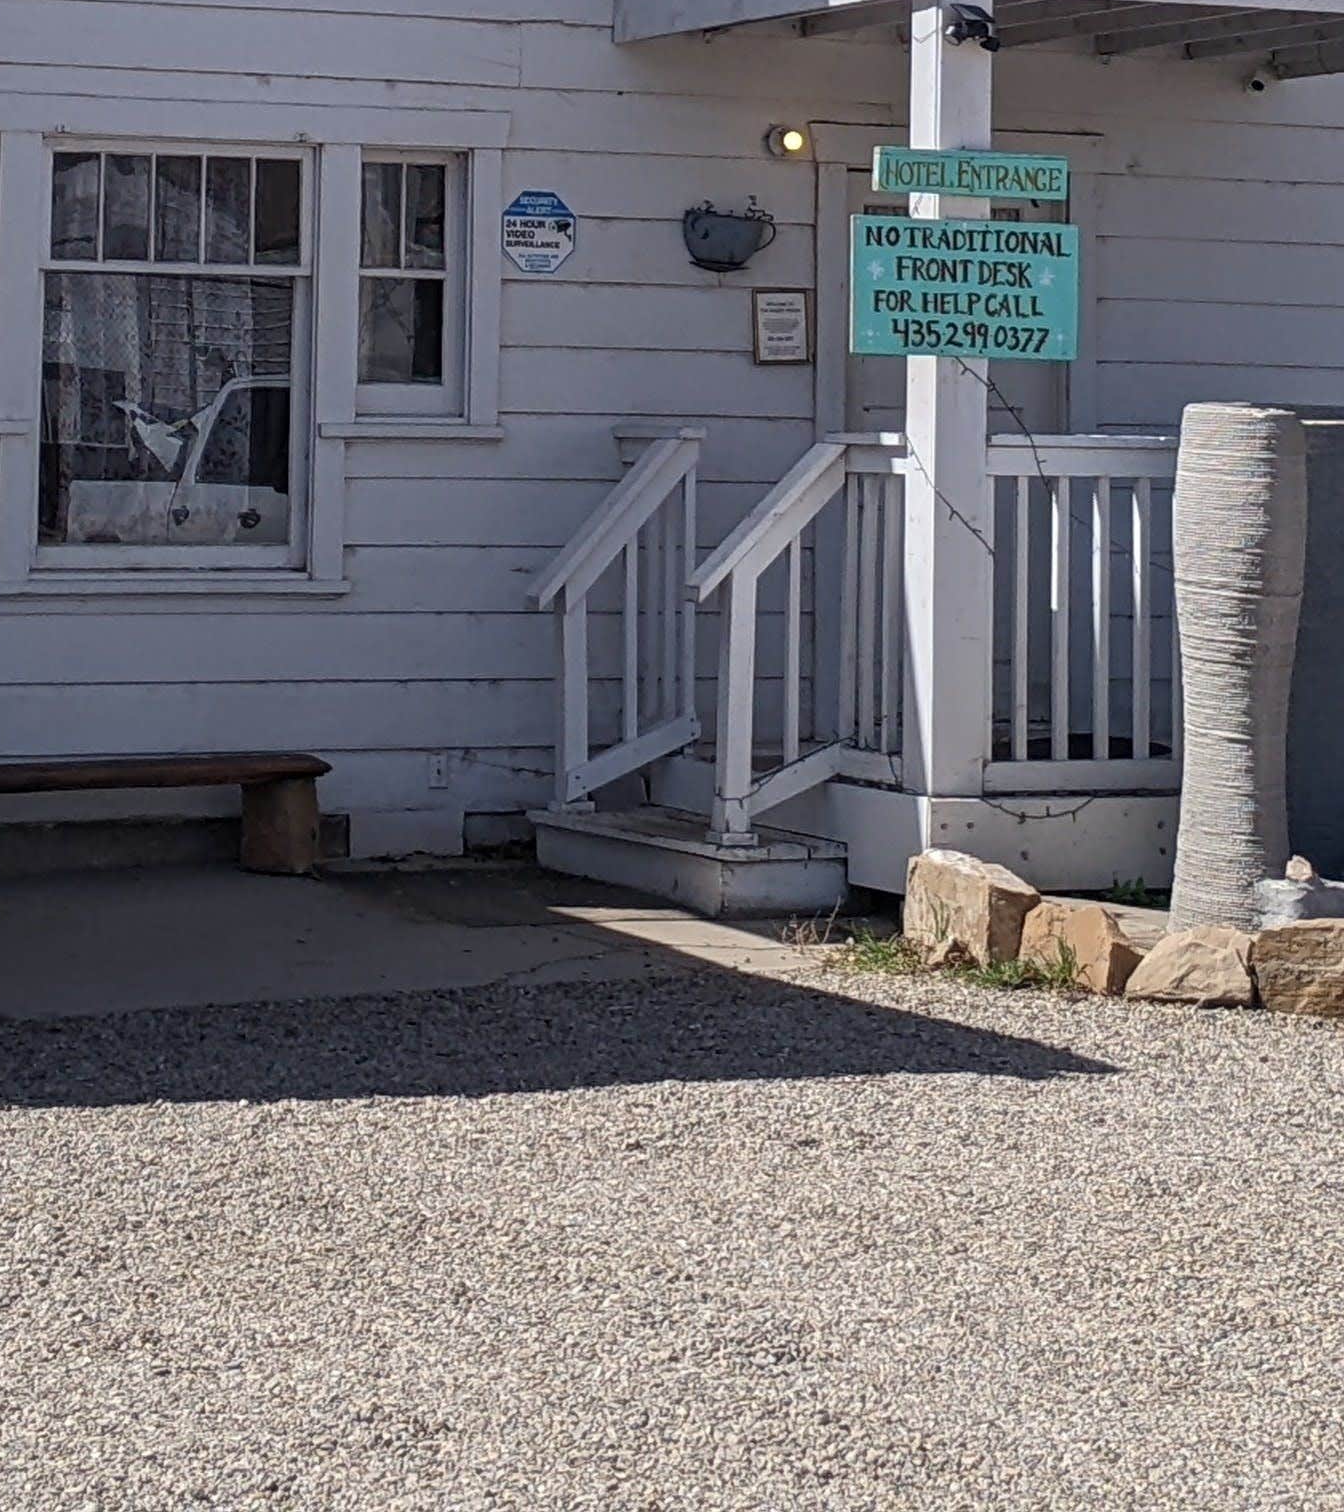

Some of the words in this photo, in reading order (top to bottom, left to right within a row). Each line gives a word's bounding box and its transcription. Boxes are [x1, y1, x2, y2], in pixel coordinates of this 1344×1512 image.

[885, 158, 952, 188] HOTEL
[958, 160, 1062, 192] ENTRANCE
[506, 219, 517, 228] 24
[520, 219, 546, 229] HOUR
[506, 229, 535, 239] VIDEO
[505, 240, 560, 250] SURVEILLANCE
[865, 226, 901, 247] NO
[905, 227, 1072, 258] TRADITIONAL
[896, 256, 974, 283] FRONT
[978, 261, 1032, 289] DESK
[874, 290, 916, 312] FOR
[922, 292, 981, 316] HELP
[985, 294, 1044, 319] CALL
